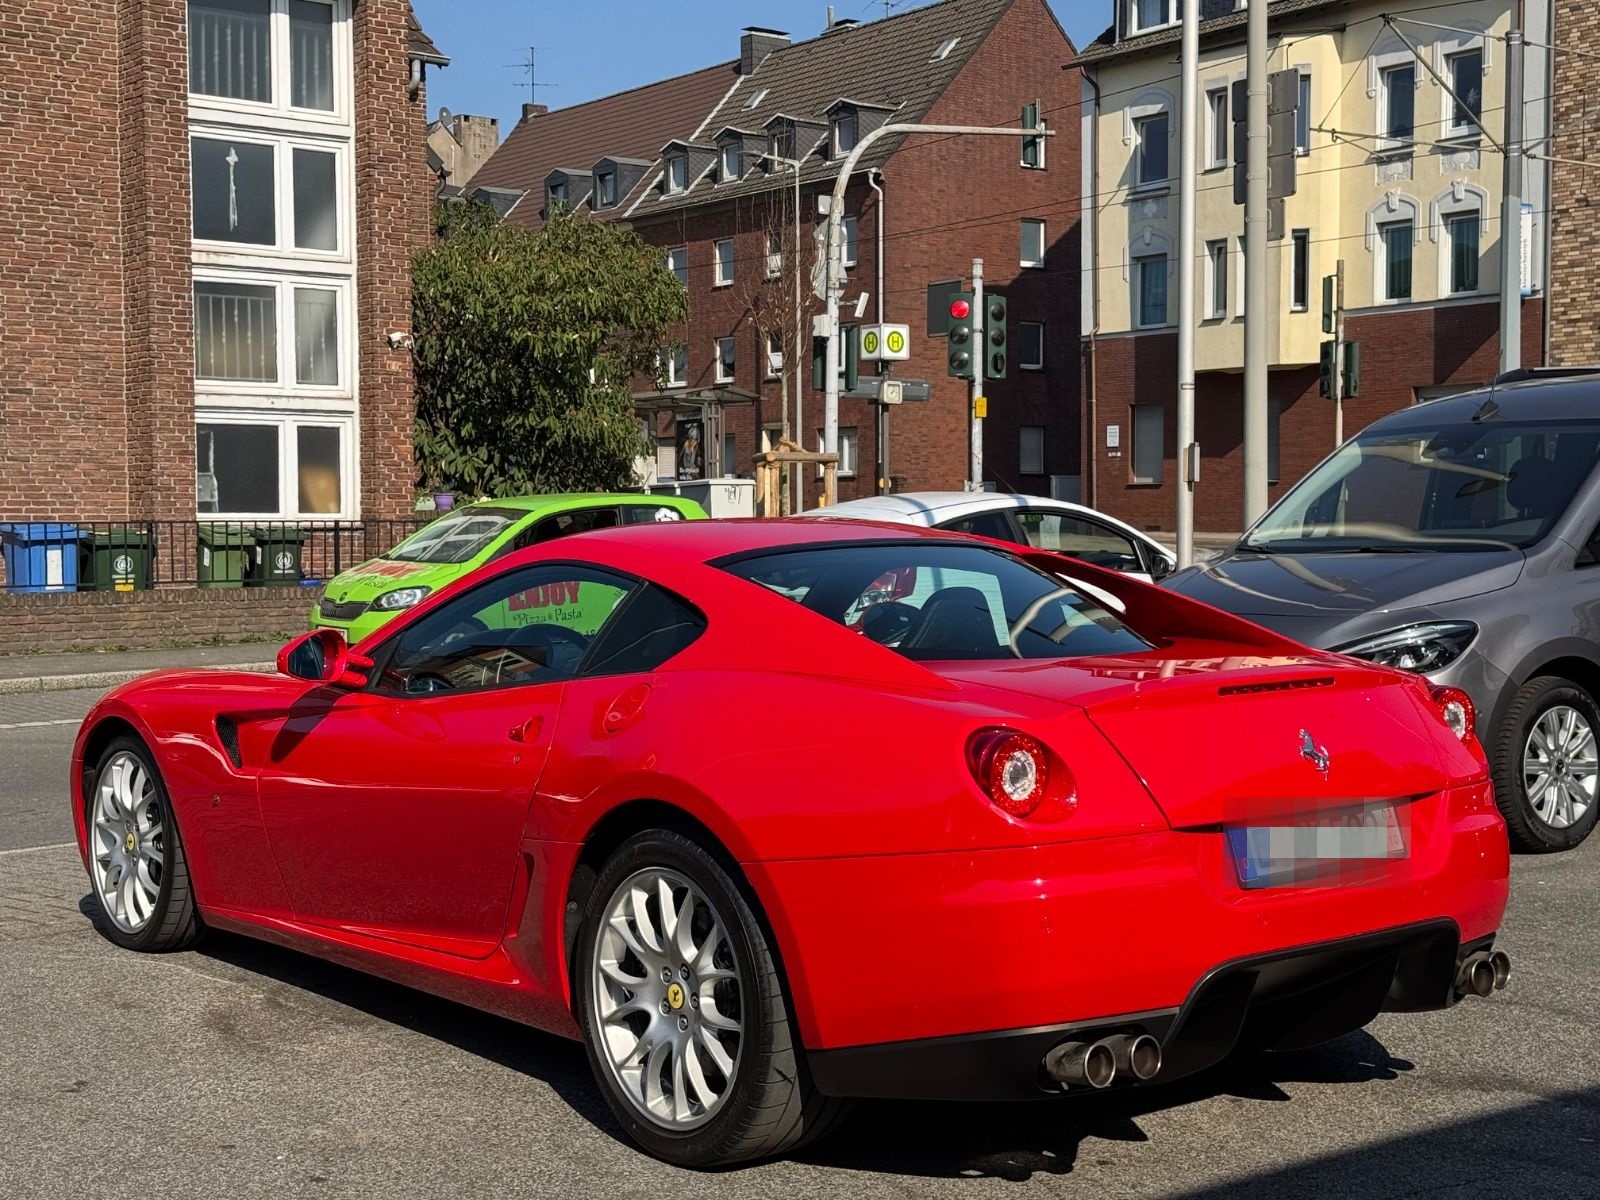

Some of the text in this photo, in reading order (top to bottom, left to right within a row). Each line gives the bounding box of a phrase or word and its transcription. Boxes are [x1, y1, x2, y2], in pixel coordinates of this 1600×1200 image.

[868, 336, 874, 349] H
[892, 335, 900, 348] H
[508, 581, 580, 612] ENJOY
[513, 612, 546, 626] Pizza
[555, 608, 582, 622] Pasta
